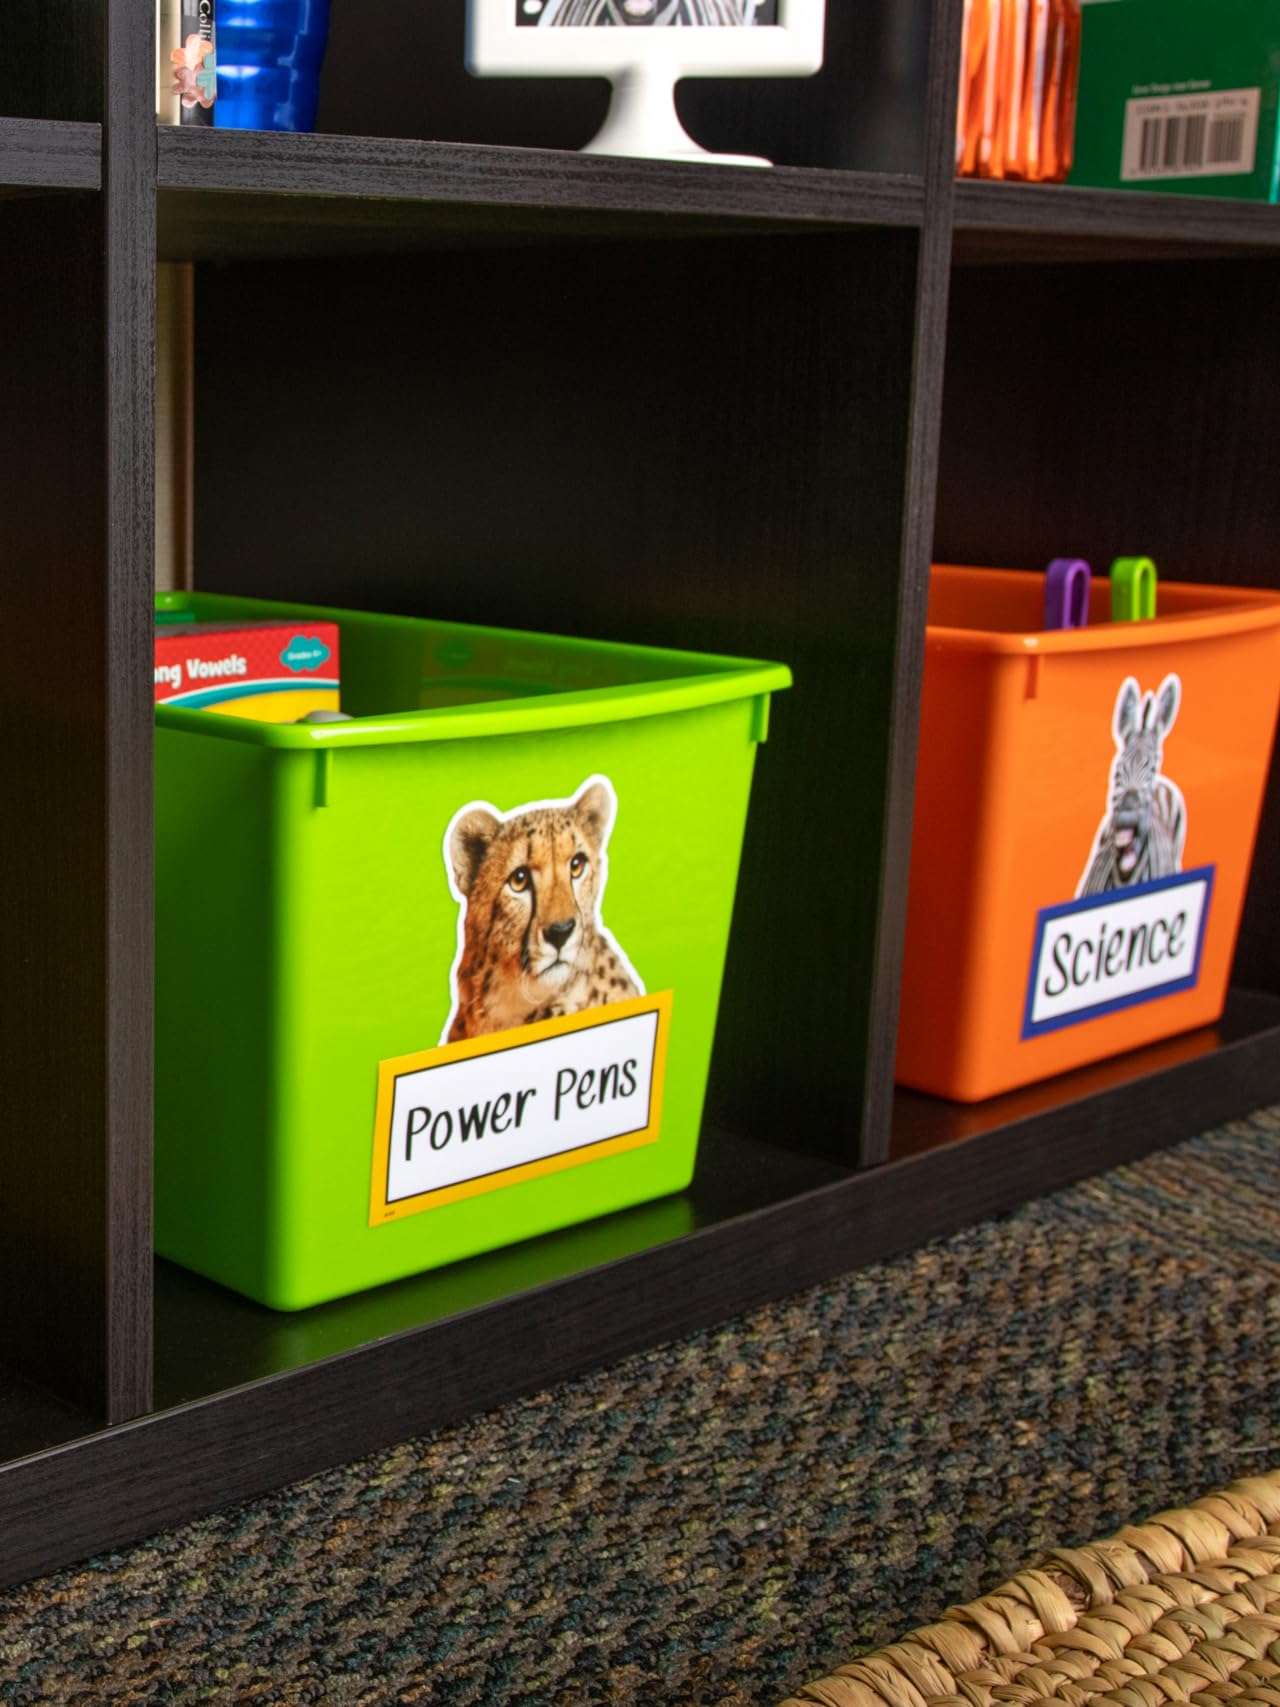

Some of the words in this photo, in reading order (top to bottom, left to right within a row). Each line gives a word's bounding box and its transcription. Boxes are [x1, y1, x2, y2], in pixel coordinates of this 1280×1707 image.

[186, 654, 247, 679] Vowels
[1043, 909, 1188, 998] Science
[404, 1088, 537, 1162] Power
[553, 1058, 638, 1122] Pens
